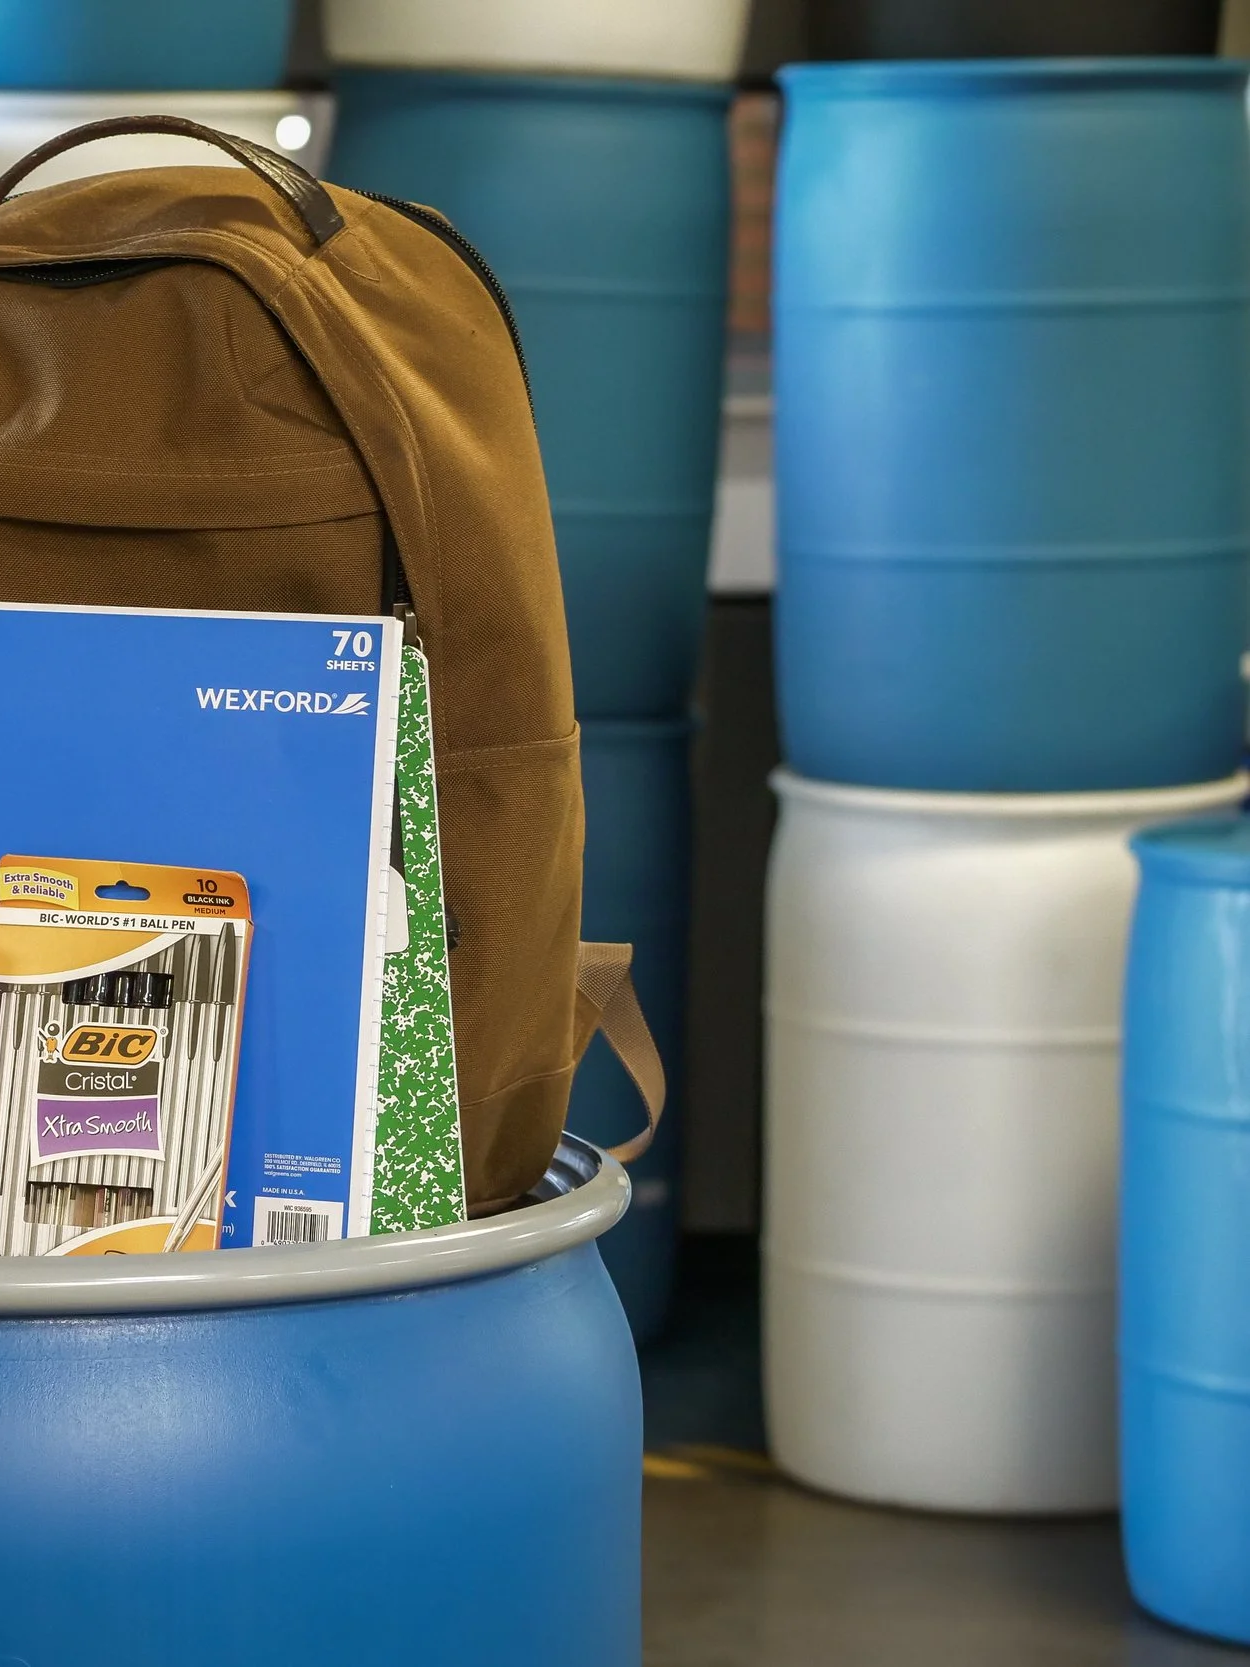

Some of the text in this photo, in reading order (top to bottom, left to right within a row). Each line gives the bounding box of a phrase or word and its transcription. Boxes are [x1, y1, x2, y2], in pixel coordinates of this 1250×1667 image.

[332, 630, 373, 658] 70
[326, 660, 375, 672] SHEETS
[196, 687, 332, 714] WEXFORD
[4, 872, 74, 891] Extra Smooth
[196, 879, 217, 893] 10
[12, 885, 66, 900] & Reliable
[187, 895, 230, 905] BLACK INK
[194, 907, 227, 915] MEDIUM
[39, 913, 196, 930] BIC-WORLD'S #1 BALL PEN
[41, 1111, 153, 1138] Xtra Smooth
